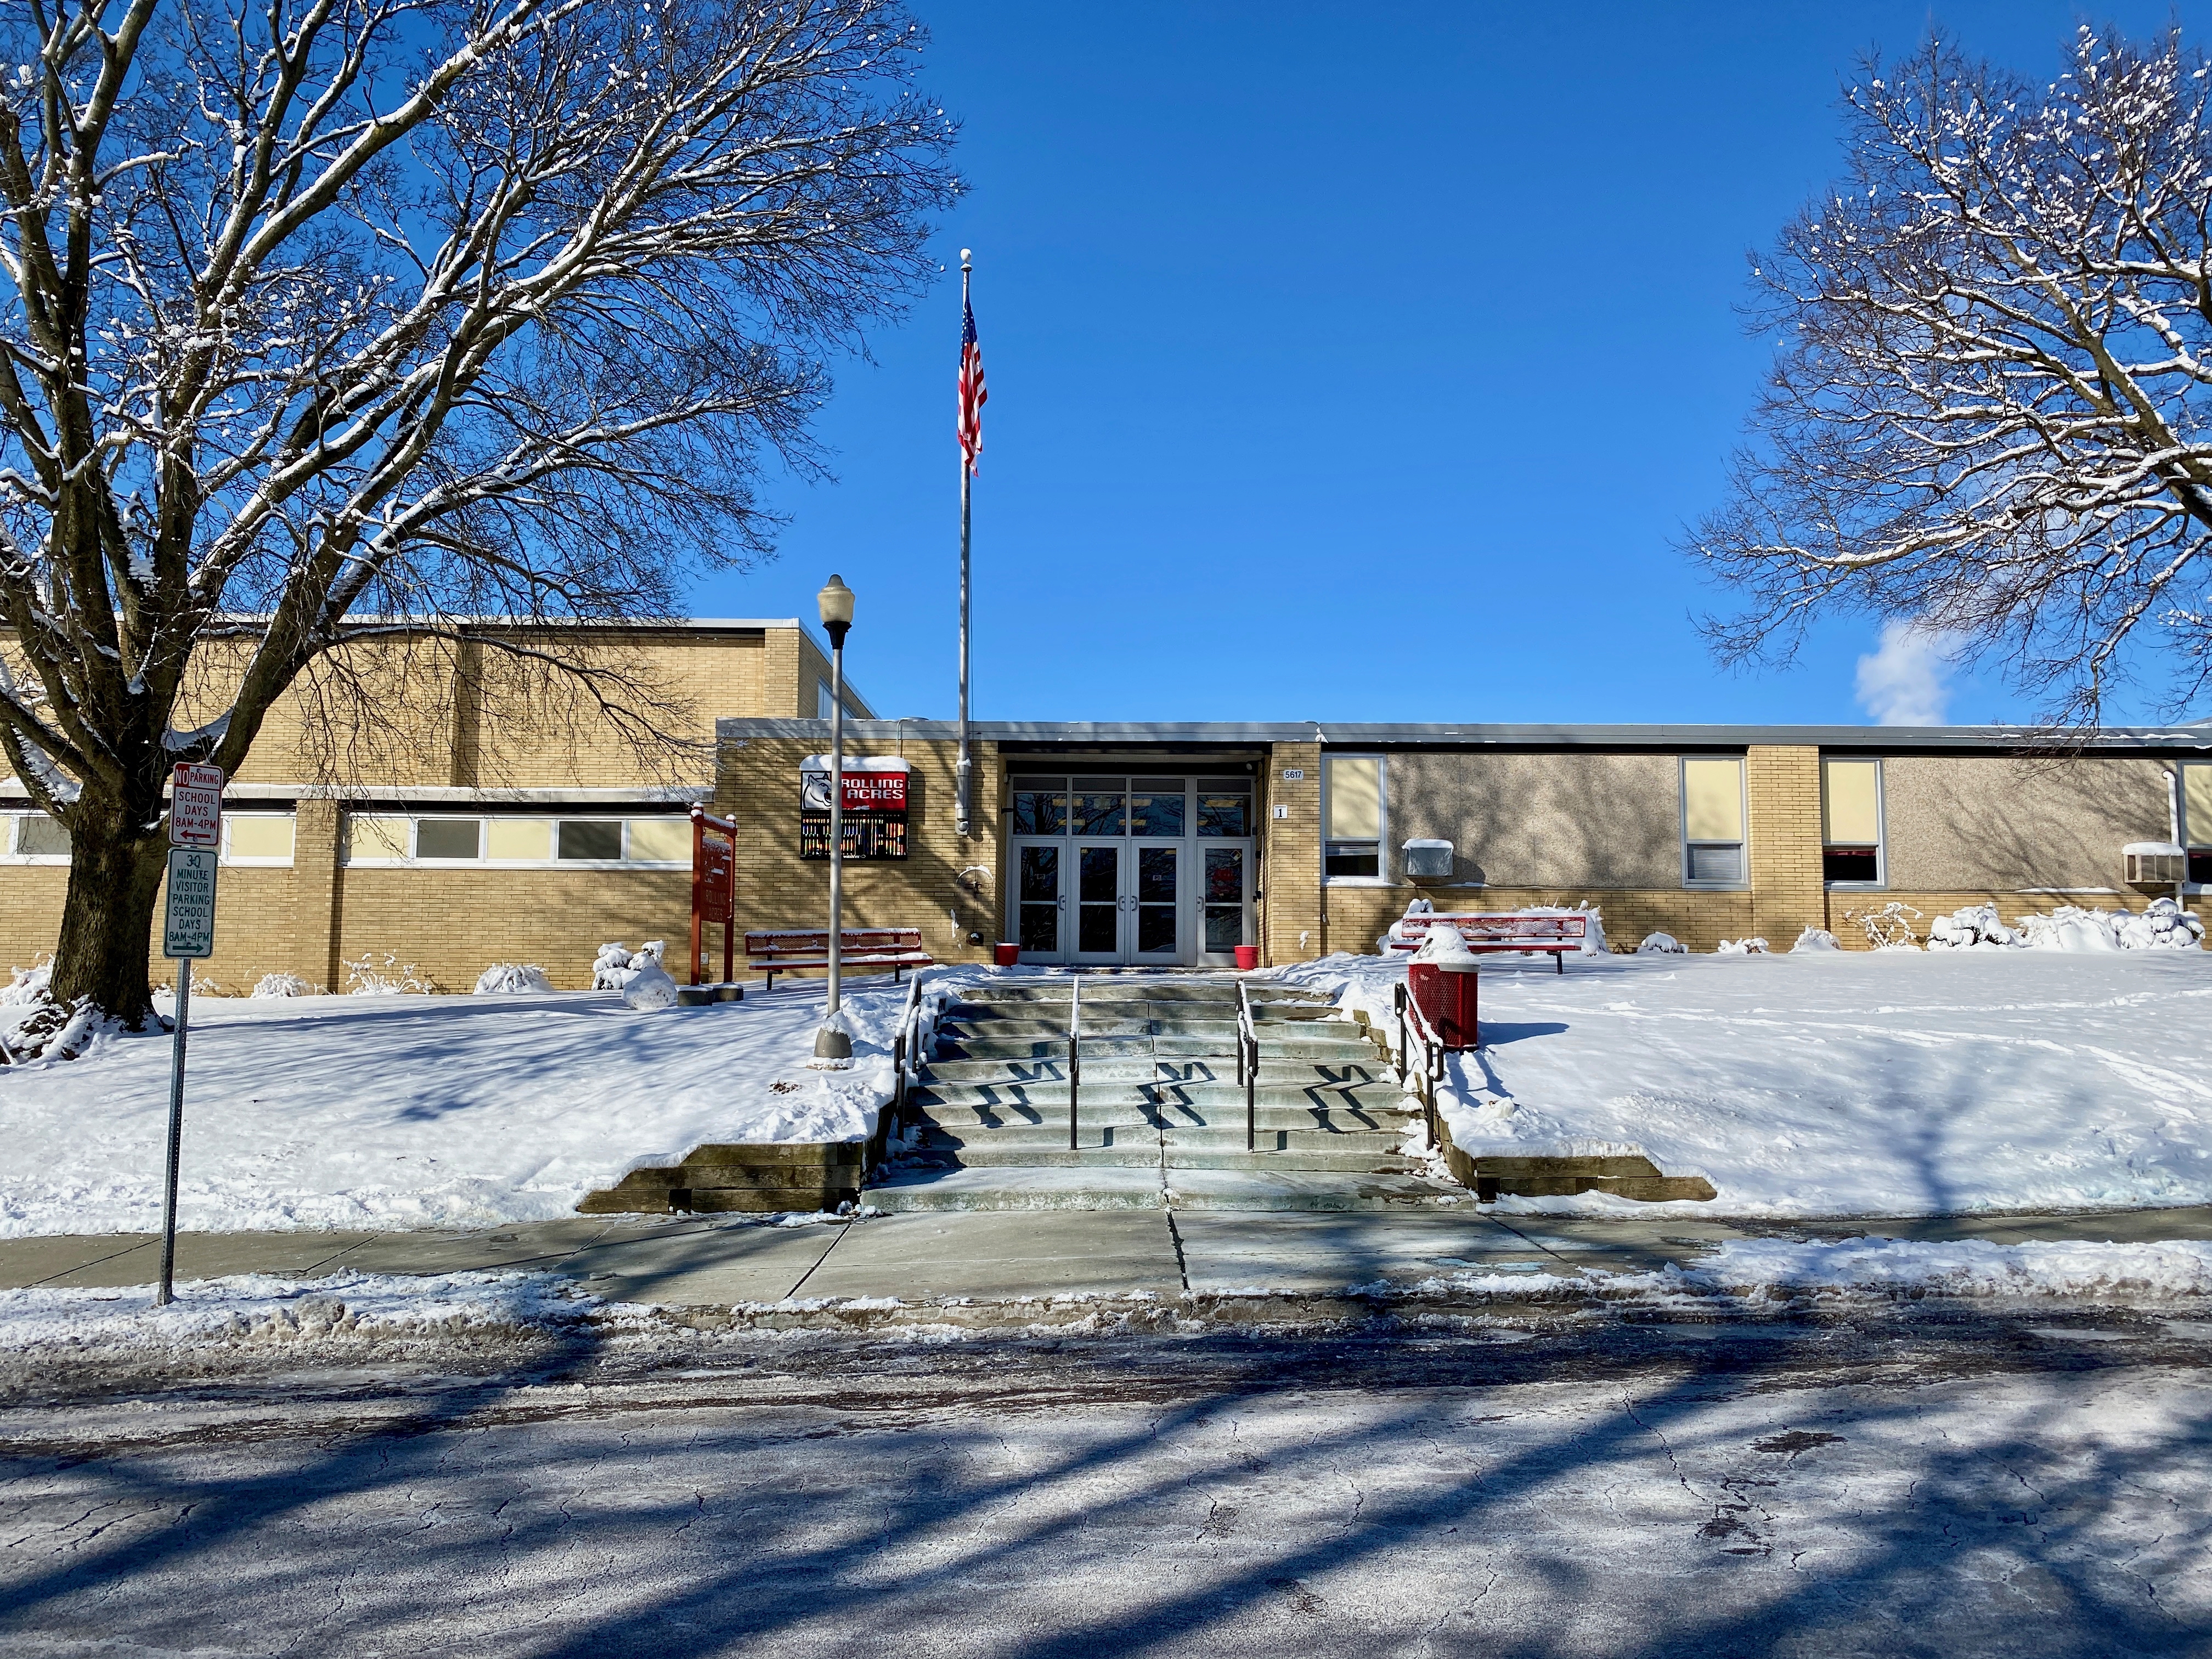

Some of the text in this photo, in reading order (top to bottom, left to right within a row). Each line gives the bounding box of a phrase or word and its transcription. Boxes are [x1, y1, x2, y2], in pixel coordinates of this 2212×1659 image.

[176, 769, 219, 785] NO PARKING
[841, 779, 904, 788] ROLLING
[178, 791, 216, 804] SCHOOL
[847, 789, 904, 799] ACRES
[185, 805, 208, 816] DAYS
[1279, 808, 1283, 817] 1
[176, 817, 216, 830] 8AM-4PM
[187, 855, 201, 867] 30
[177, 869, 208, 880] MINUTE
[176, 881, 208, 893] VISITOR
[173, 894, 210, 905] PARKING
[173, 906, 208, 917] SCHOOL
[179, 918, 201, 929] DAYS
[169, 932, 210, 942] 8AM-4PM
